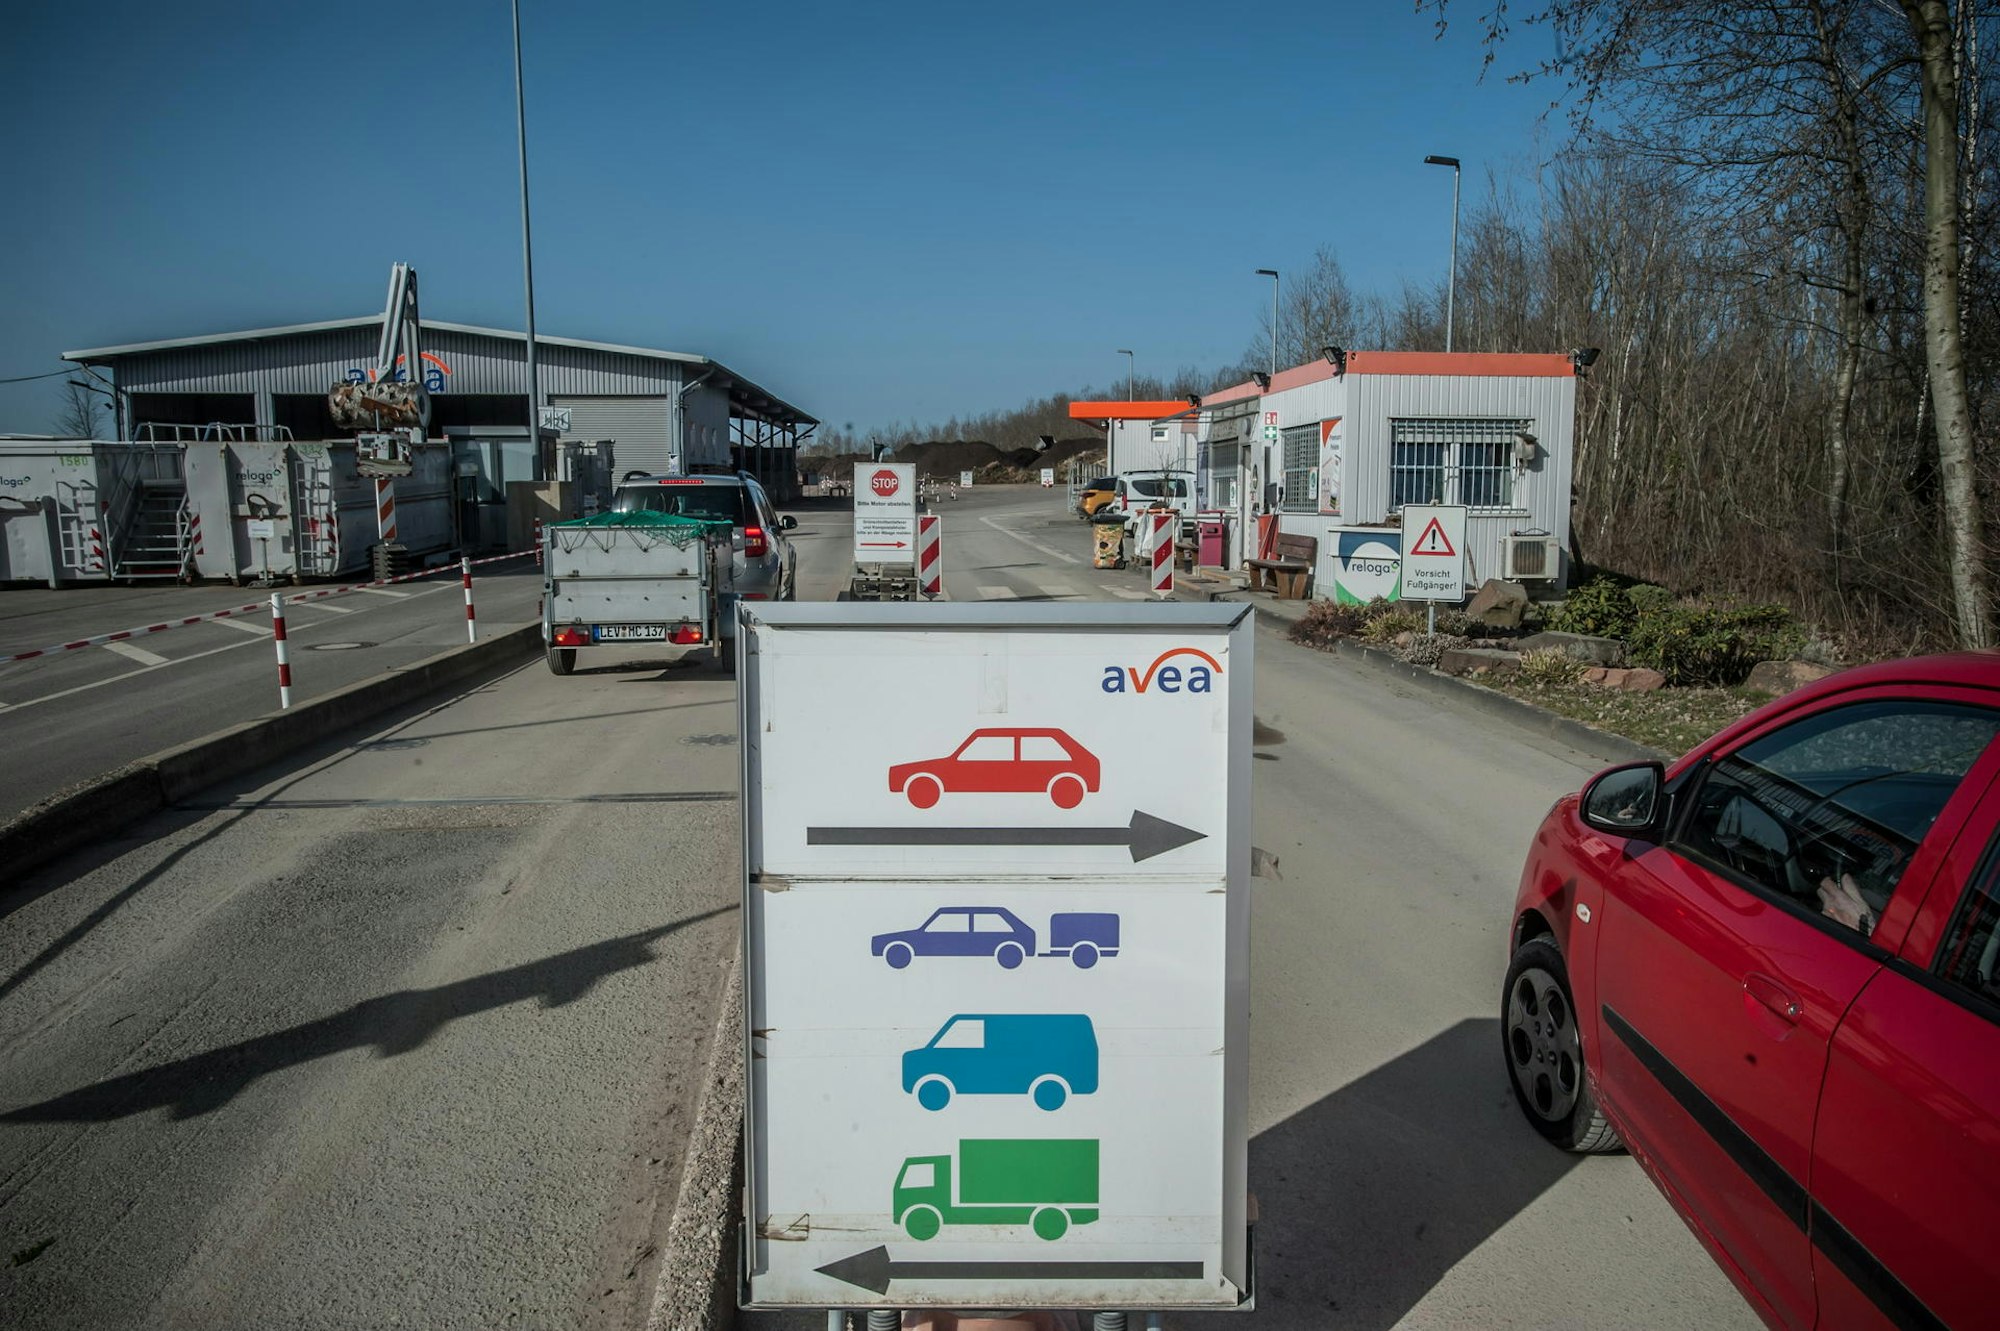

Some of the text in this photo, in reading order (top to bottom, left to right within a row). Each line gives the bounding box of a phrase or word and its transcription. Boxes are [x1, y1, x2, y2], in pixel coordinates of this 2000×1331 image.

[348, 352, 451, 391] aa
[60, 456, 88, 466] 1580
[0, 476, 23, 487] loga
[236, 469, 272, 484] reloga
[872, 478, 898, 489] STOP
[1352, 560, 1390, 576] reloga
[1415, 570, 1450, 578] Vorsicht
[1407, 580, 1456, 590] Fußgänger!
[600, 626, 620, 637] LEV
[644, 625, 663, 637] 137
[1101, 648, 1223, 693] avea
